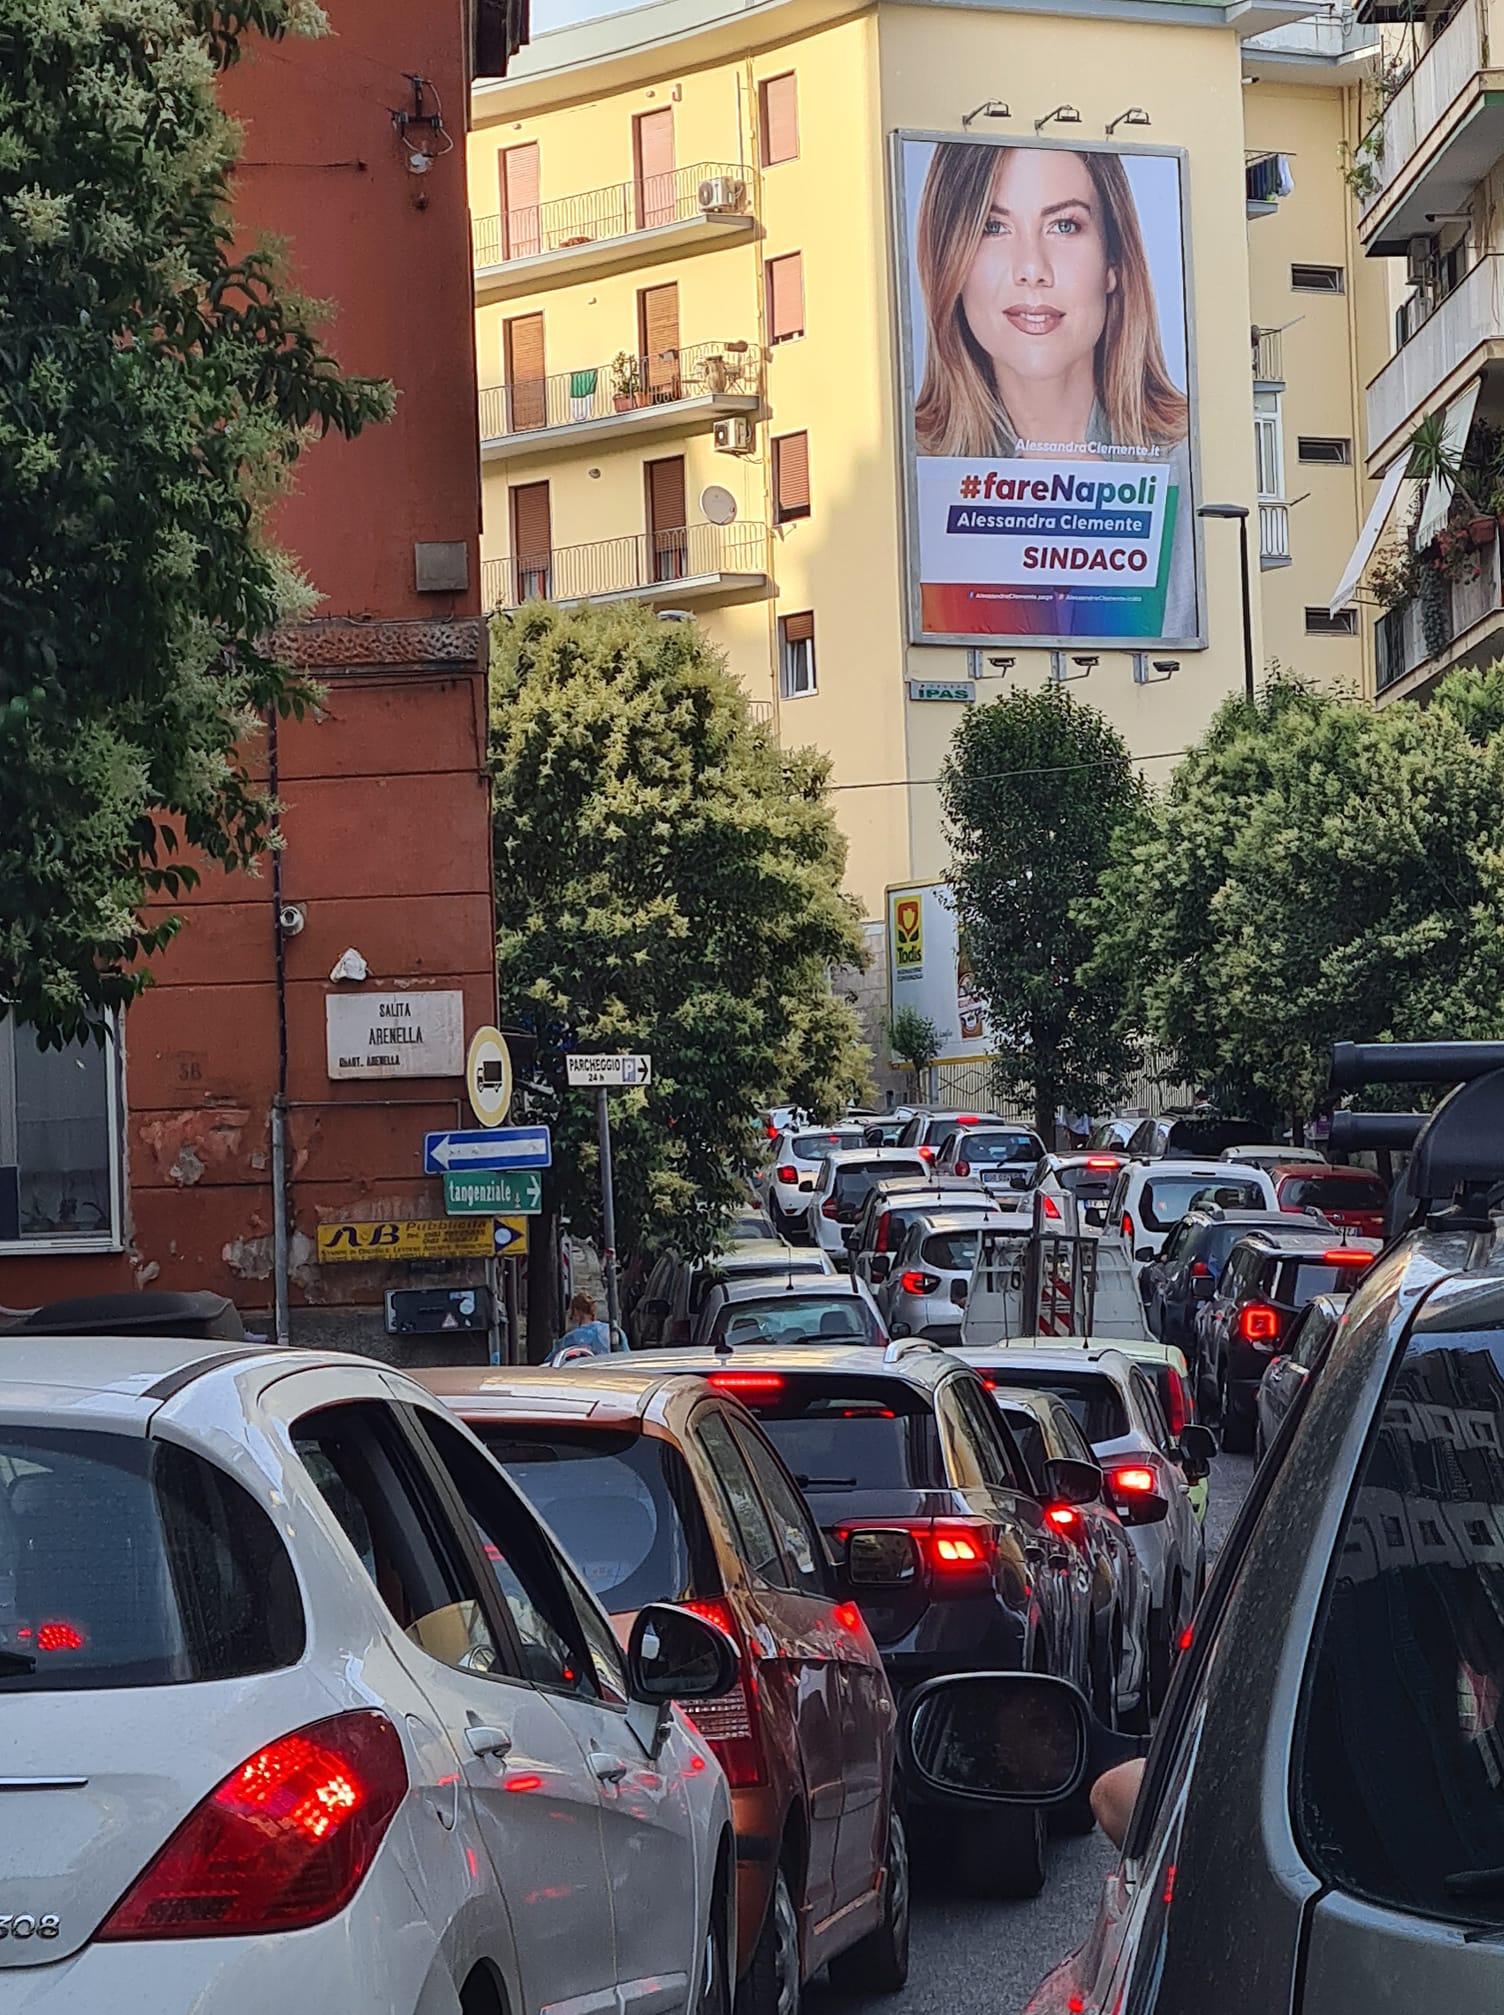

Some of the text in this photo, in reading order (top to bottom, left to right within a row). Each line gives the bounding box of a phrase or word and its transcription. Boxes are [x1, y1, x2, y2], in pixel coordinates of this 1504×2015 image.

[1015, 439, 1161, 457] AlessandraClemente.it
[960, 472, 1157, 508] #fareNapoli
[957, 512, 1142, 532] Alessandra Clemente
[1023, 546, 1148, 572] SINDACO
[379, 1003, 411, 1018] SALITA
[368, 1026, 423, 1045] ARENELLA
[569, 1058, 621, 1072] PARCHEGGIO
[449, 1180, 512, 1207] tangenziale
